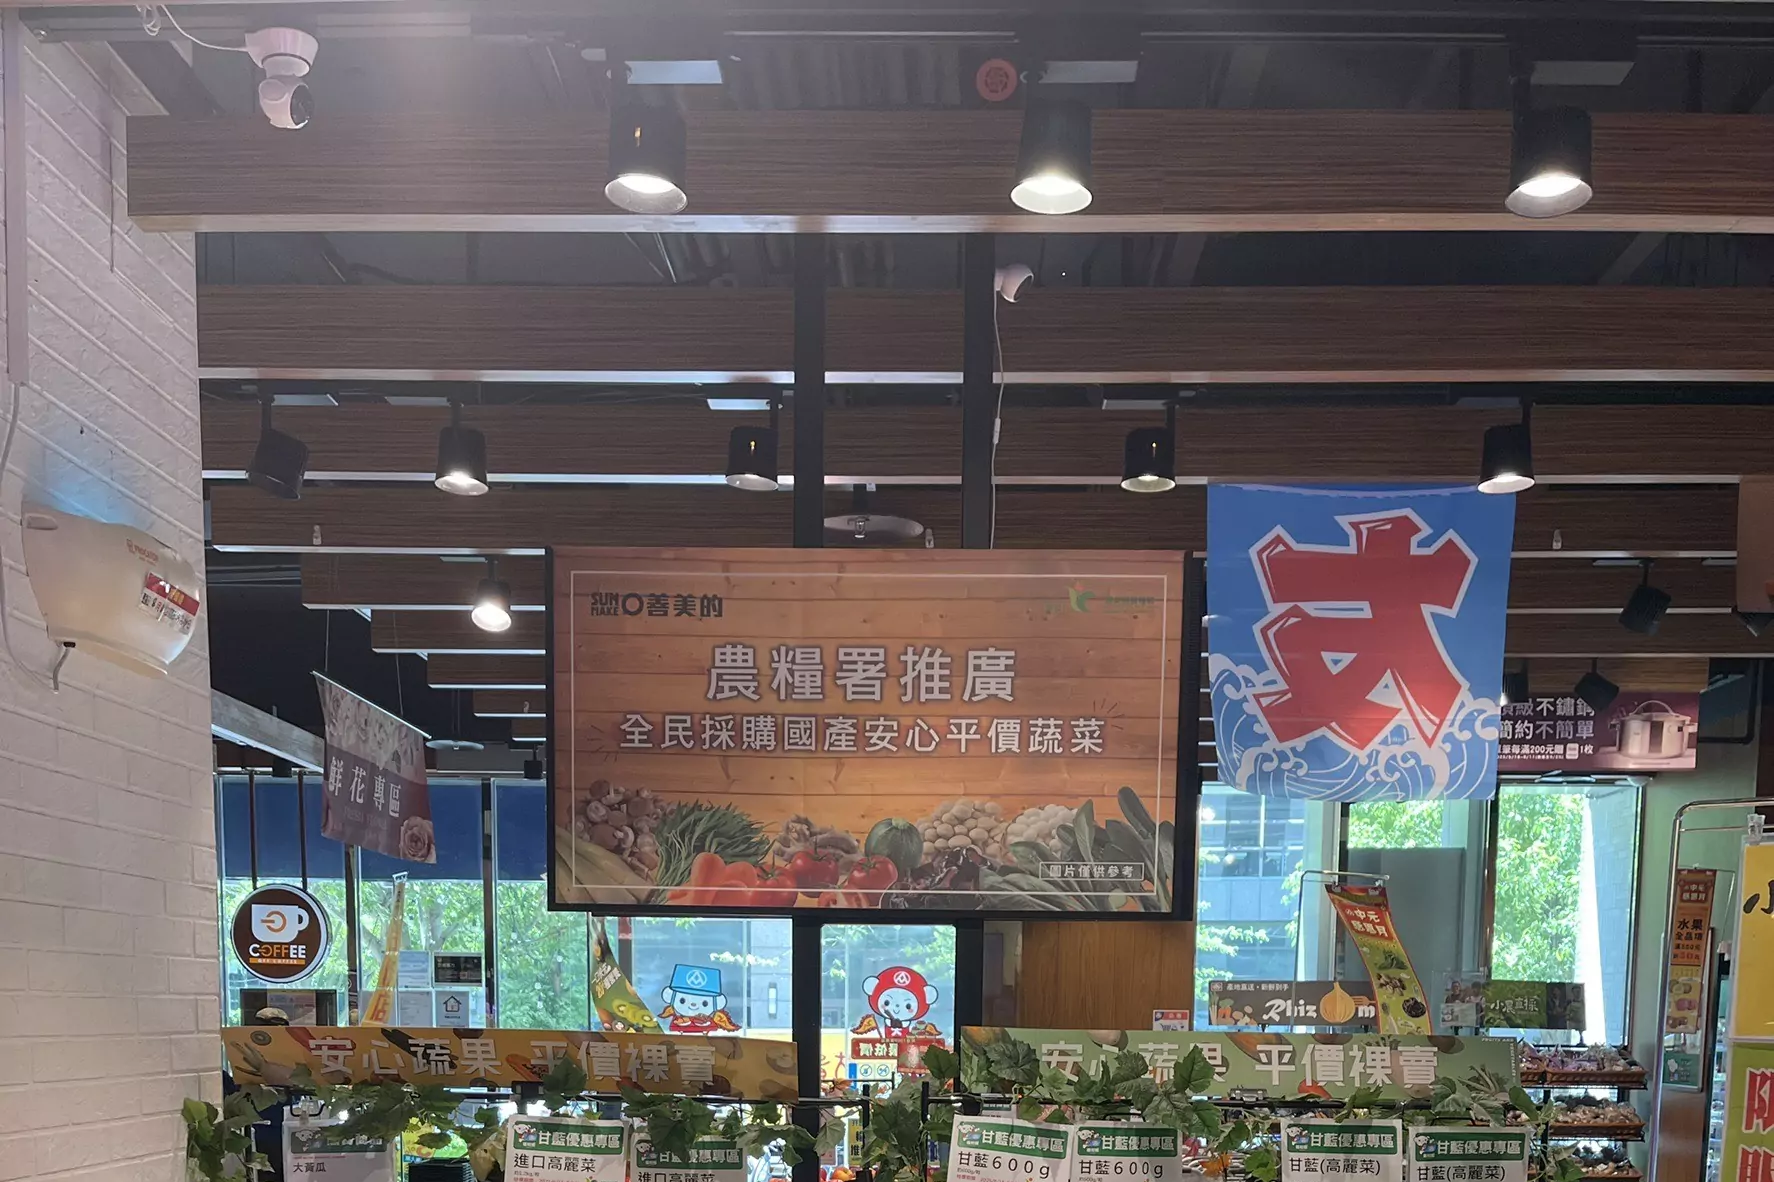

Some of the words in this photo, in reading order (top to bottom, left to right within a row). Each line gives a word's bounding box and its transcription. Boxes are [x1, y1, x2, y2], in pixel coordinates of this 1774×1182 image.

[647, 593, 723, 617] 善美的
[706, 645, 1017, 703] 農糧署推廣
[620, 713, 1106, 755] 全民採購國產安心平價蔬菜
[328, 756, 401, 817] 鮮花專區
[1050, 864, 1134, 878] 圖片僅供參考
[249, 944, 306, 958] COFFEE
[309, 1037, 501, 1077] 安心蔬果
[531, 1041, 717, 1086] 平價裸賣
[1255, 1043, 1439, 1088] 平價裸賣
[539, 1131, 620, 1149] 甘藍優惠專區
[981, 1130, 1065, 1153] 甘藍優惠專區
[1101, 1136, 1175, 1151] 甘藍優惠專區
[1310, 1133, 1394, 1148] 甘藍優惠專區
[1437, 1140, 1522, 1155] 甘藍優惠專區
[293, 1162, 326, 1173] 大黃瓜
[514, 1153, 596, 1173] 進口高麗菜
[1289, 1157, 1381, 1175] 甘藍(高麗菜)
[1417, 1165, 1506, 1182] 甘藍(高麗菜)
